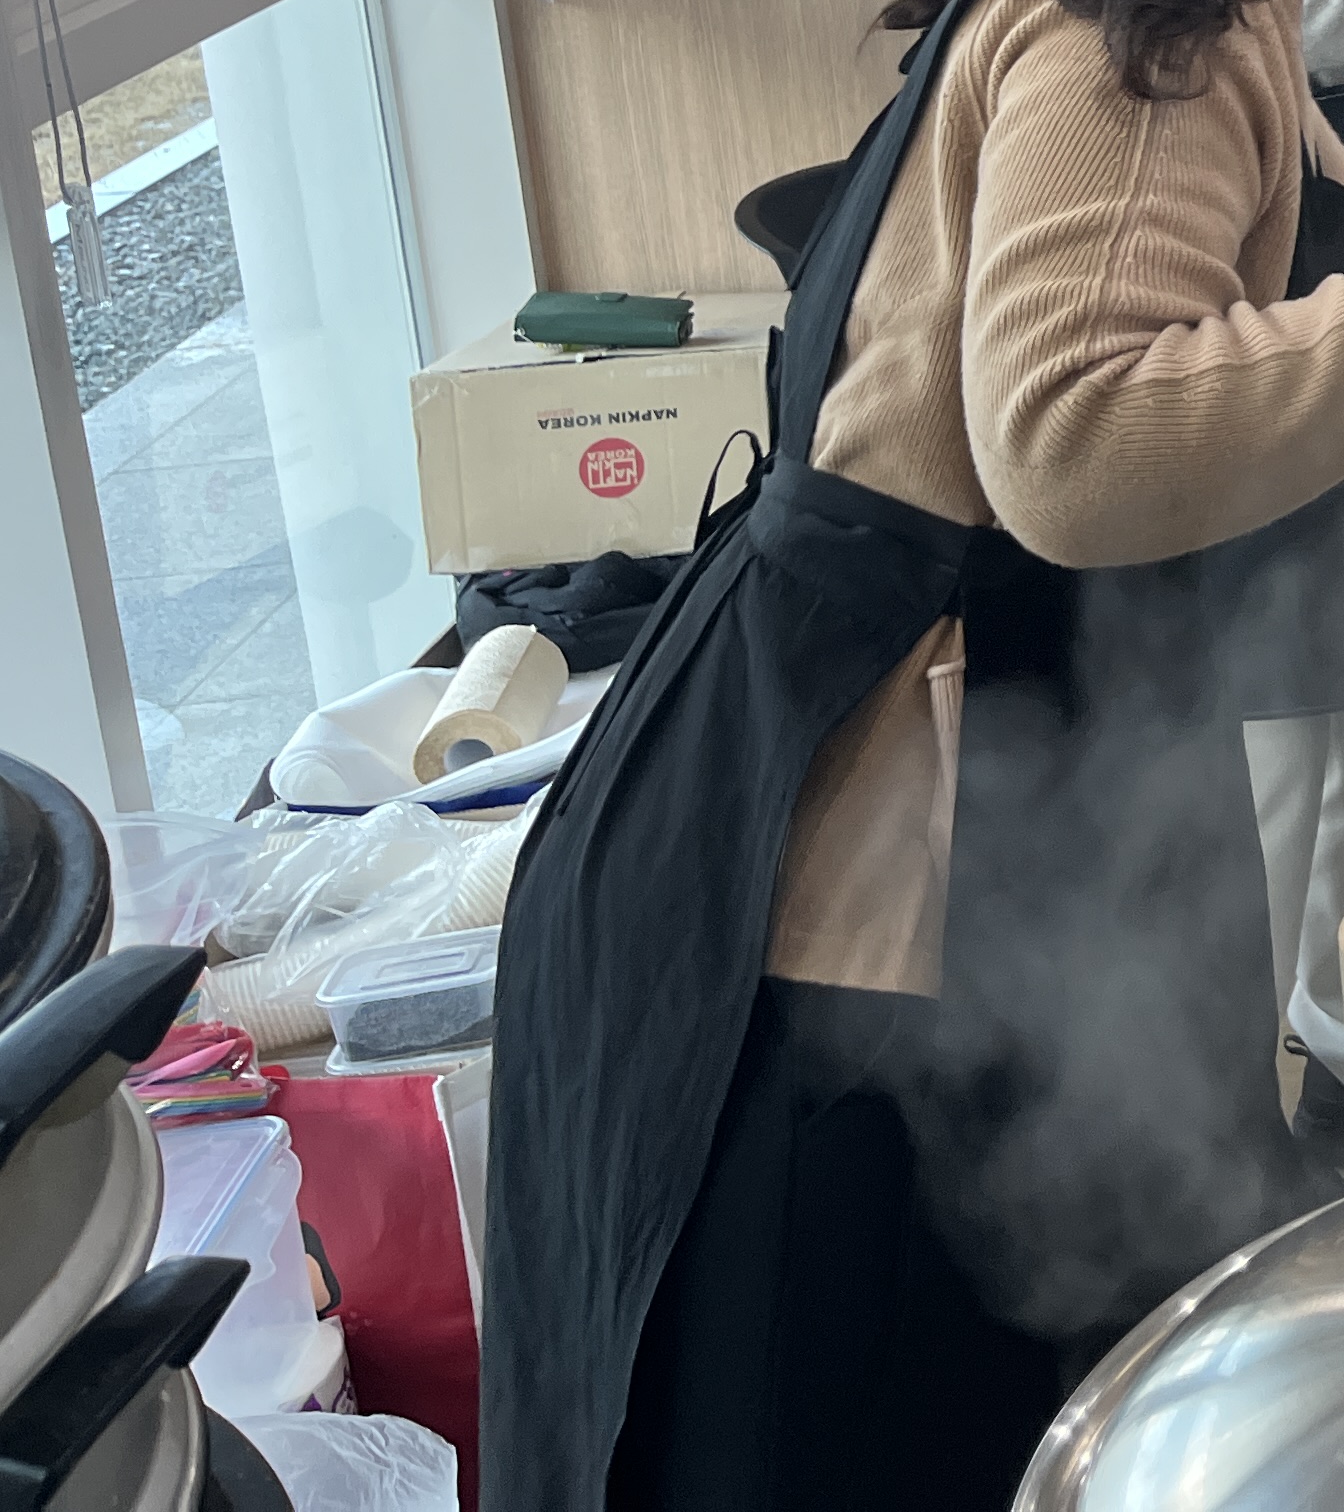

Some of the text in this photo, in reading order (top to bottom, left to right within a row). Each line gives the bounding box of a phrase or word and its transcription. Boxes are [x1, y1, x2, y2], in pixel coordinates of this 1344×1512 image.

[537, 407, 678, 430] NAPKIN KOREA
[587, 448, 636, 461] KOREA
